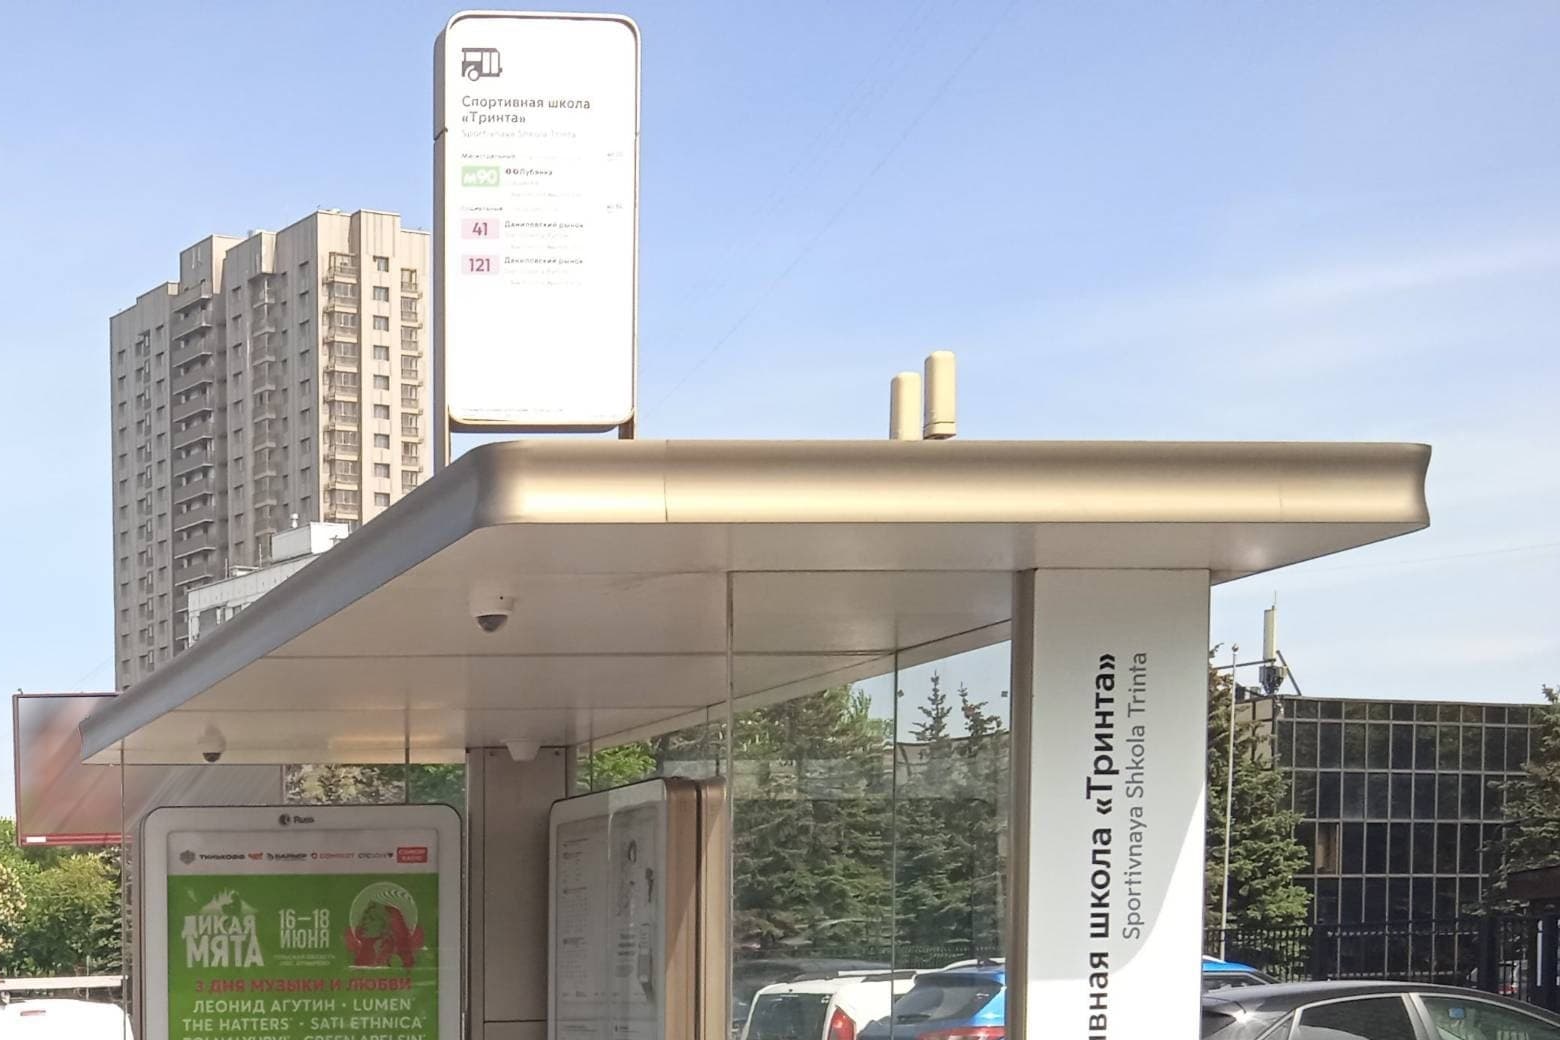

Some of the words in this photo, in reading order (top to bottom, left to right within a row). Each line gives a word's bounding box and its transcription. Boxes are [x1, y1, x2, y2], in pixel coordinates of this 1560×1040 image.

[462, 96, 544, 109] Спортивная
[548, 99, 591, 109] школа
[462, 111, 526, 124] «Тринта»
[472, 221, 488, 237] 41
[469, 257, 491, 273] 121
[1128, 651, 1148, 718] Trinta
[1086, 652, 1120, 815] «Тринта»
[1126, 725, 1146, 798] Shkola
[1123, 803, 1147, 939] Sportivnaya
[1089, 827, 1112, 938] школа
[181, 915, 256, 939] ДИКАЯ
[280, 929, 330, 949] ИЮНЯ
[185, 935, 265, 968] МЯТА
[196, 979, 204, 992] 3
[210, 978, 245, 994] ДНЯ
[251, 977, 324, 992] МУЗЫКИ
[331, 977, 341, 991] И
[349, 976, 412, 992] ЛЮБВИ
[193, 1000, 266, 1014] ЛЕОНИД
[271, 999, 335, 1012] АГУТИН
[182, 1019, 213, 1031] THE
[311, 1017, 345, 1029] SATI
